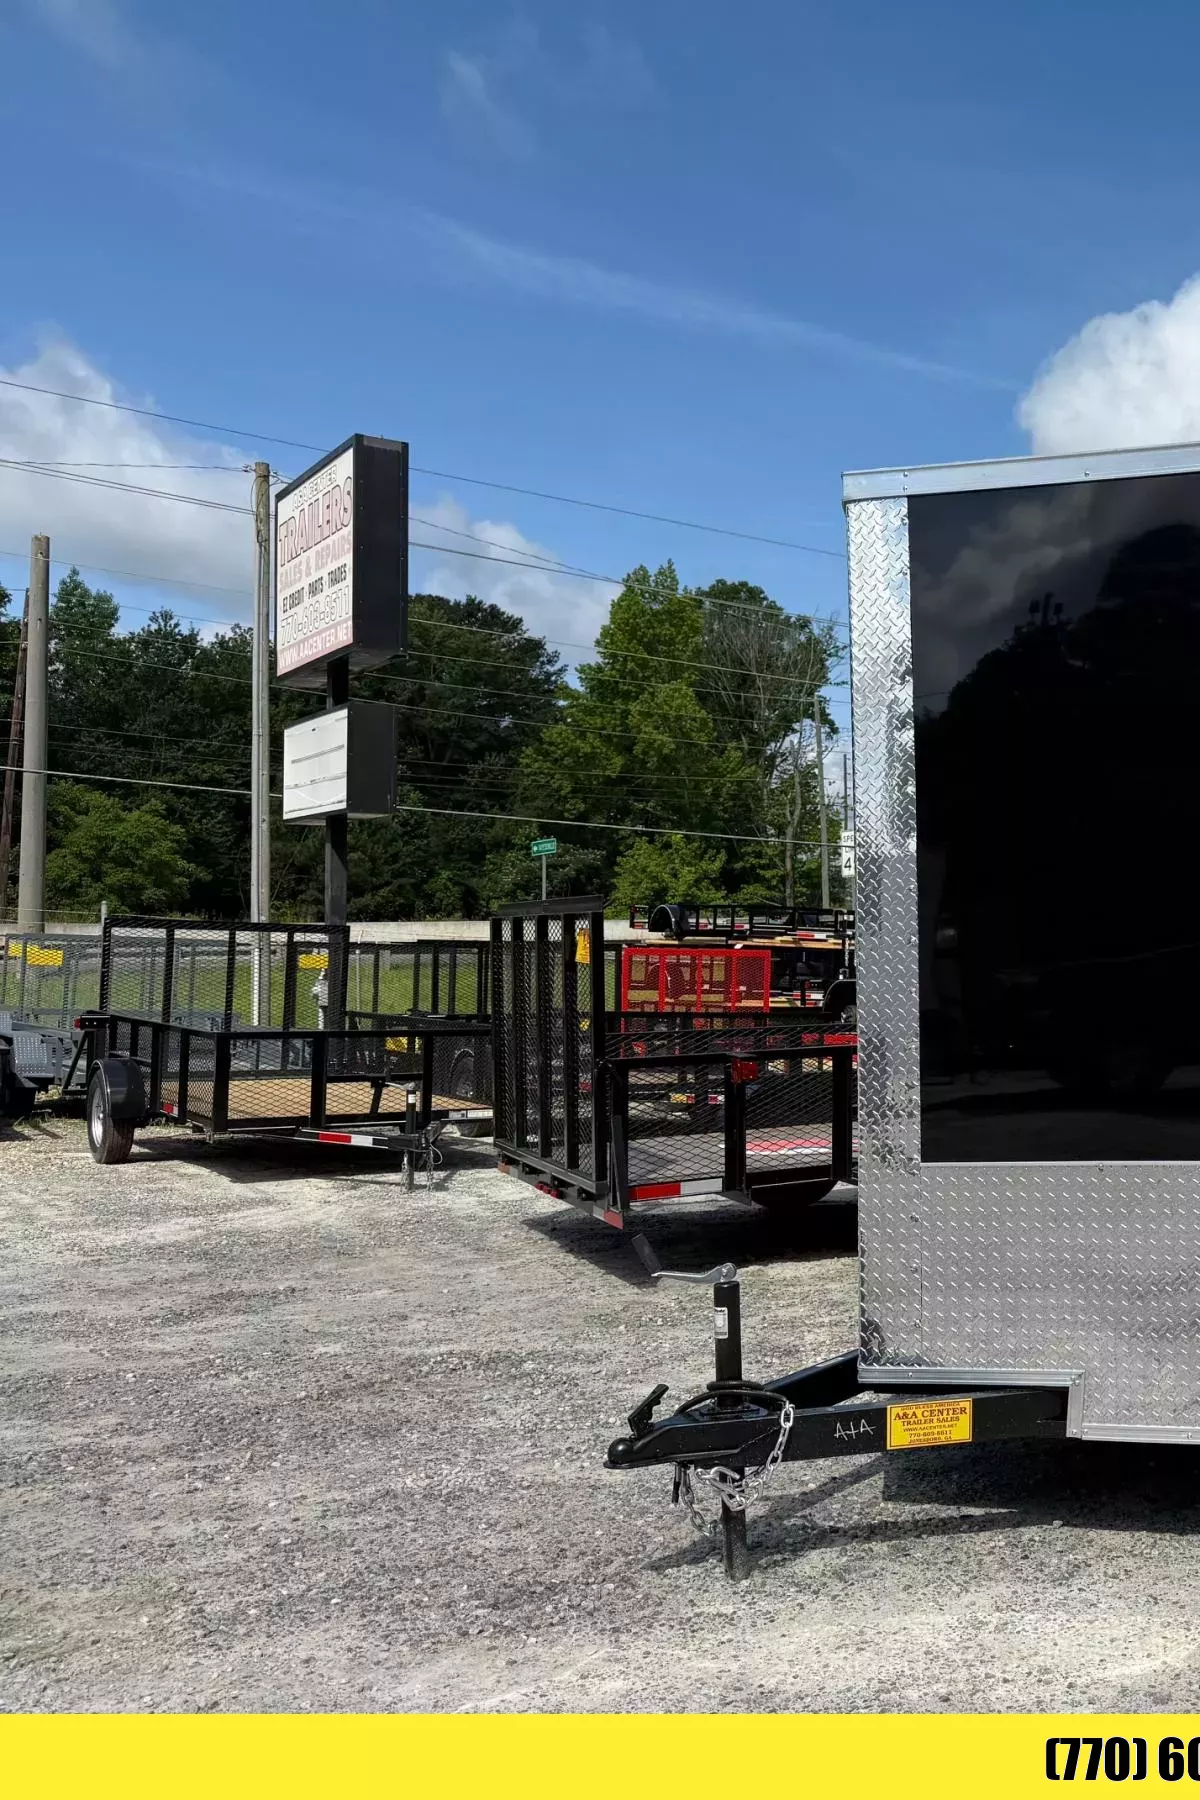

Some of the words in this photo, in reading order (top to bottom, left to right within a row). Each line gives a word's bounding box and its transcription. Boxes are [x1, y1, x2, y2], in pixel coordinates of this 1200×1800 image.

[279, 475, 352, 567] TRAILERS
[279, 558, 303, 593] SALES
[304, 555, 312, 578] &
[314, 531, 352, 573] REPAIRS
[308, 575, 324, 600] PARTS
[327, 563, 347, 589] TRADES
[280, 585, 350, 647] 770-603-8511
[894, 1411, 918, 1421] A&A
[921, 1406, 968, 1419] CENTER
[902, 1418, 934, 1427] TRAILER
[936, 1415, 960, 1423] SALES
